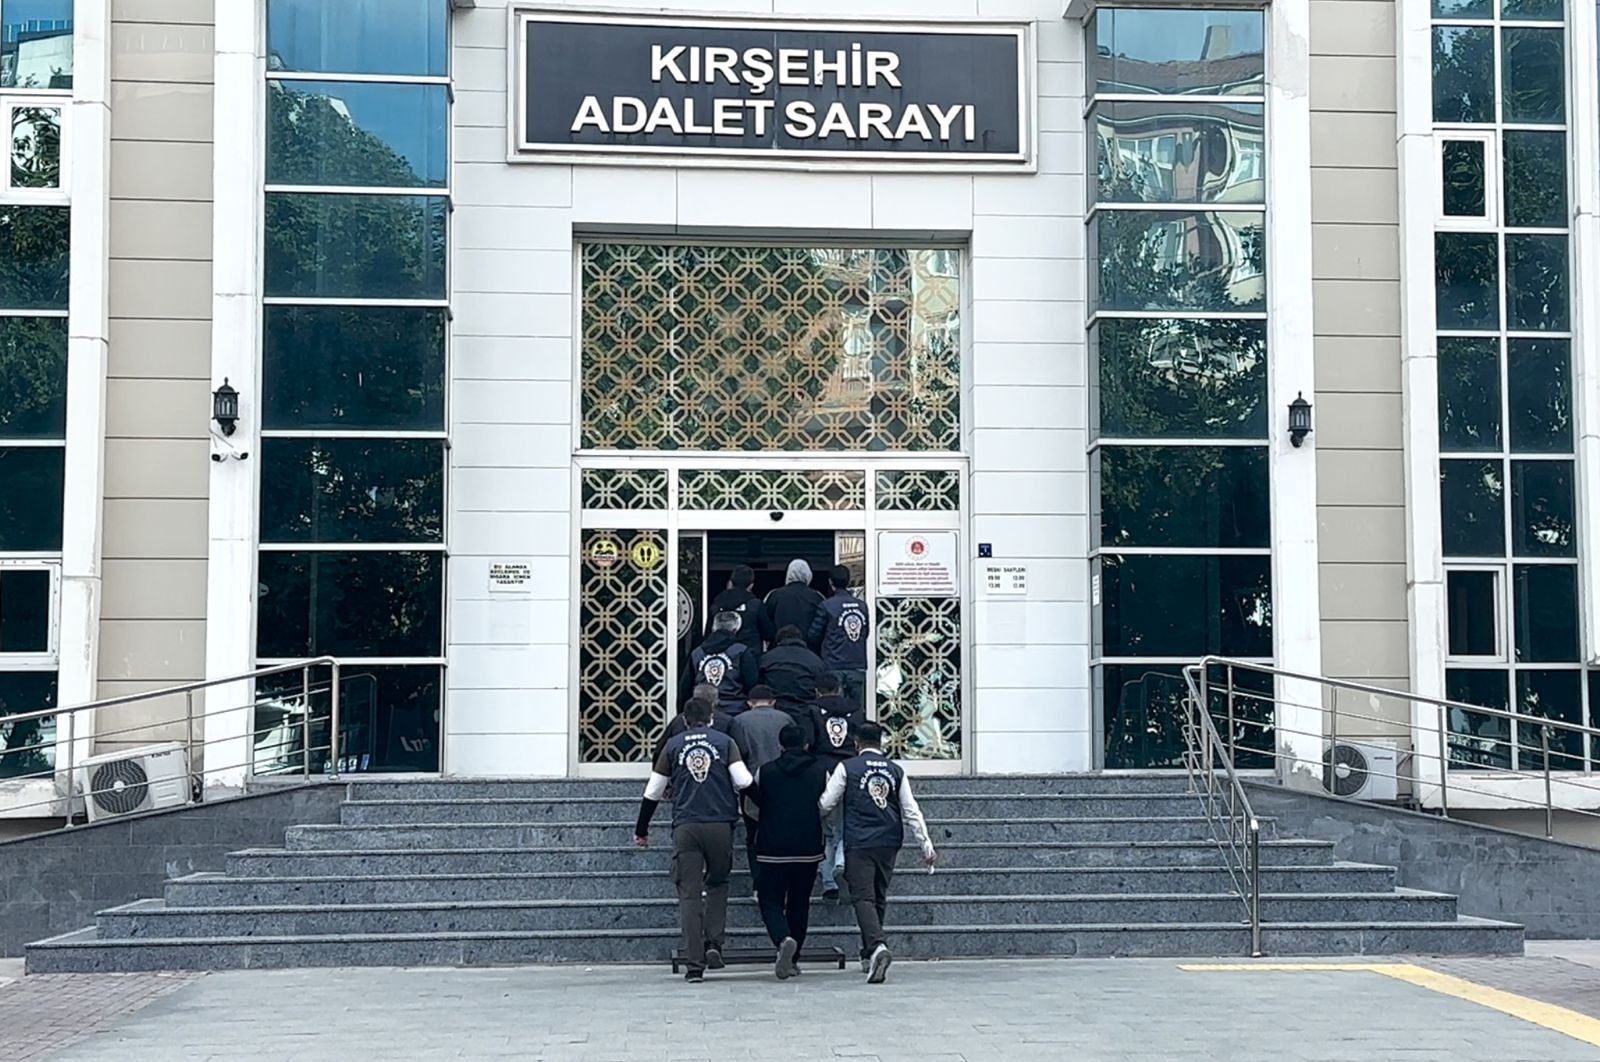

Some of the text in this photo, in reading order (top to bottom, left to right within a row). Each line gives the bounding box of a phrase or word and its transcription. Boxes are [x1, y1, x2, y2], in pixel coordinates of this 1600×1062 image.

[650, 42, 902, 94] KIRŞEHİR
[571, 96, 976, 142] ADALET SARAYI
